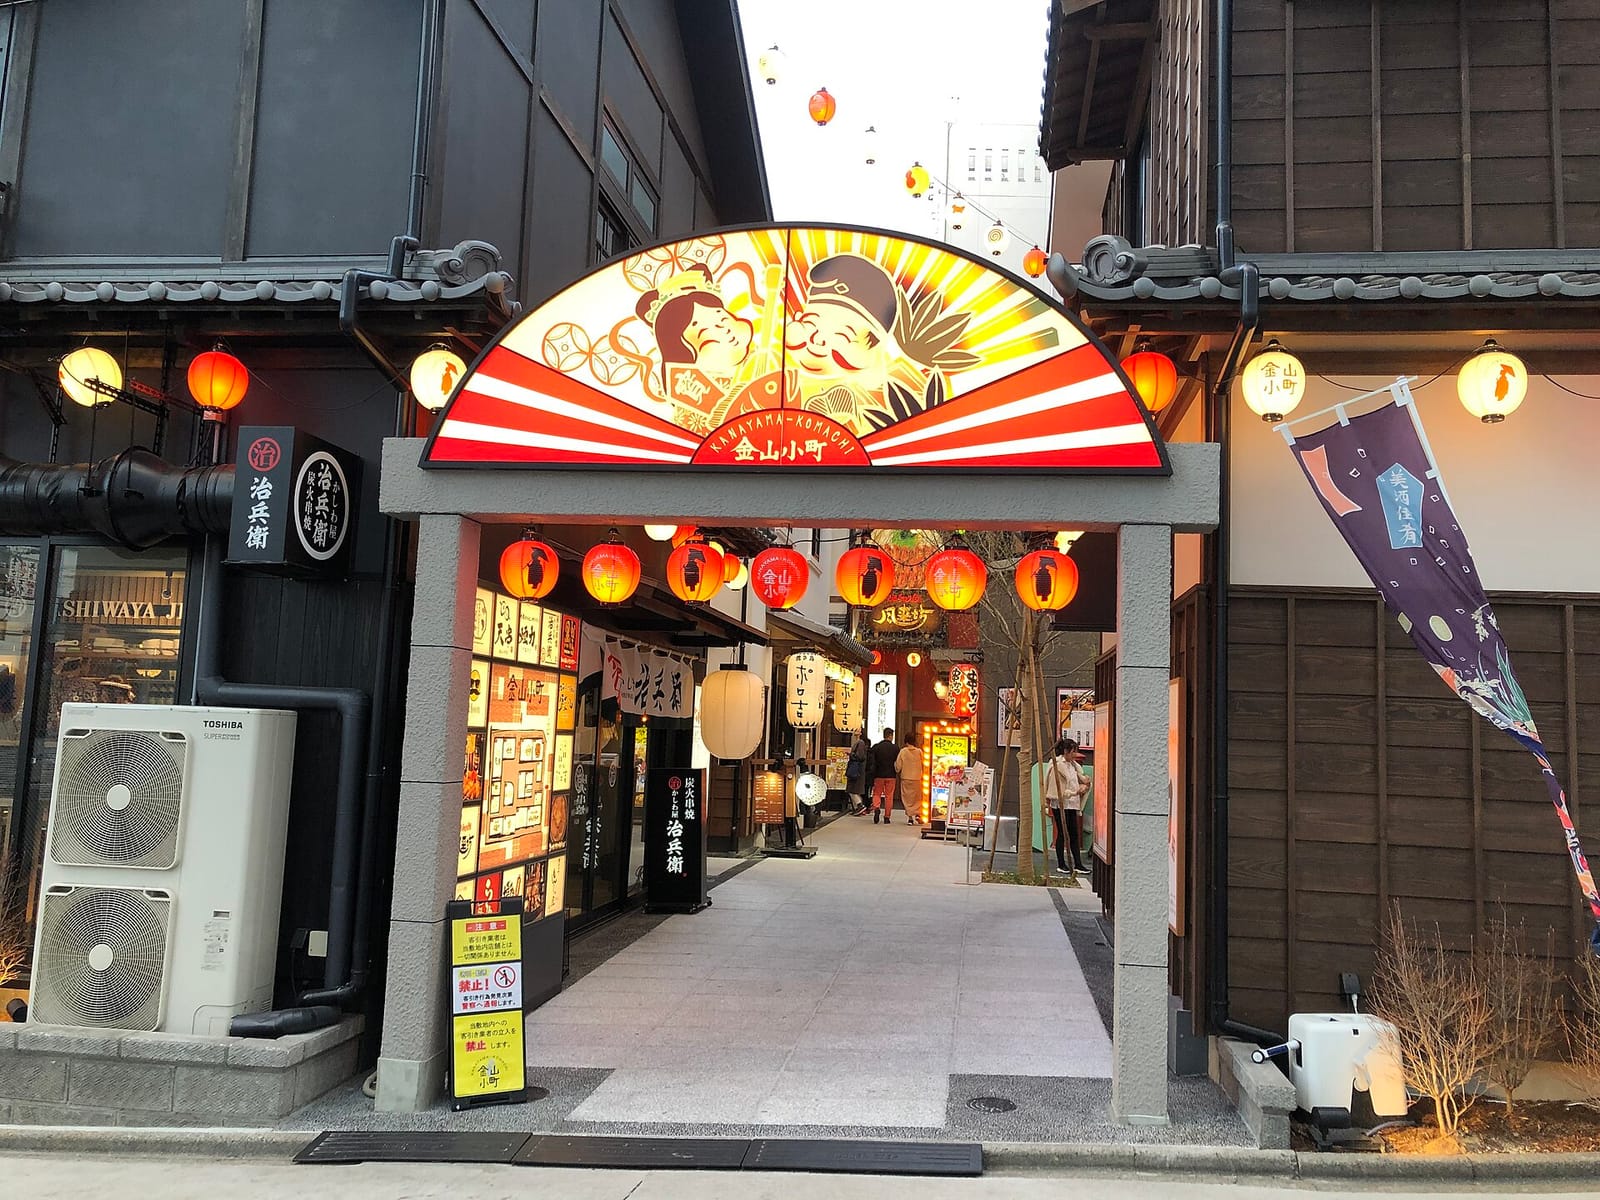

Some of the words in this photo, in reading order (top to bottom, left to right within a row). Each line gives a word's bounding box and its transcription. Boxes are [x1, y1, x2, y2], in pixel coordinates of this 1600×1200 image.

[251, 441, 278, 468] 治
[731, 436, 828, 462] 金山小町
[245, 476, 273, 549] 治兵衛
[303, 471, 316, 531] 炭火串焼
[312, 462, 333, 548] 治兵衛
[329, 481, 341, 540] かしわ屋
[57, 600, 155, 619] SHIWAYA
[507, 674, 545, 704] 金山小町
[966, 667, 979, 713] 串かつ
[203, 720, 243, 733] TOSHIBA
[671, 790, 679, 818] かしわ屋
[684, 777, 695, 820] 炭火串焼
[666, 820, 684, 874] 治兵衛
[463, 942, 513, 953] 当敷地内店舗とは
[468, 934, 507, 944] 客引き業者は
[457, 951, 517, 961] 一切関係ありません。
[462, 1000, 516, 1010] 警察へ通報します。
[463, 991, 513, 1002] 客引き行為発見次第
[461, 1028, 517, 1040] 客引き業者の立入を
[470, 1020, 507, 1030] 当敷地内への
[465, 1040, 486, 1052] 禁止
